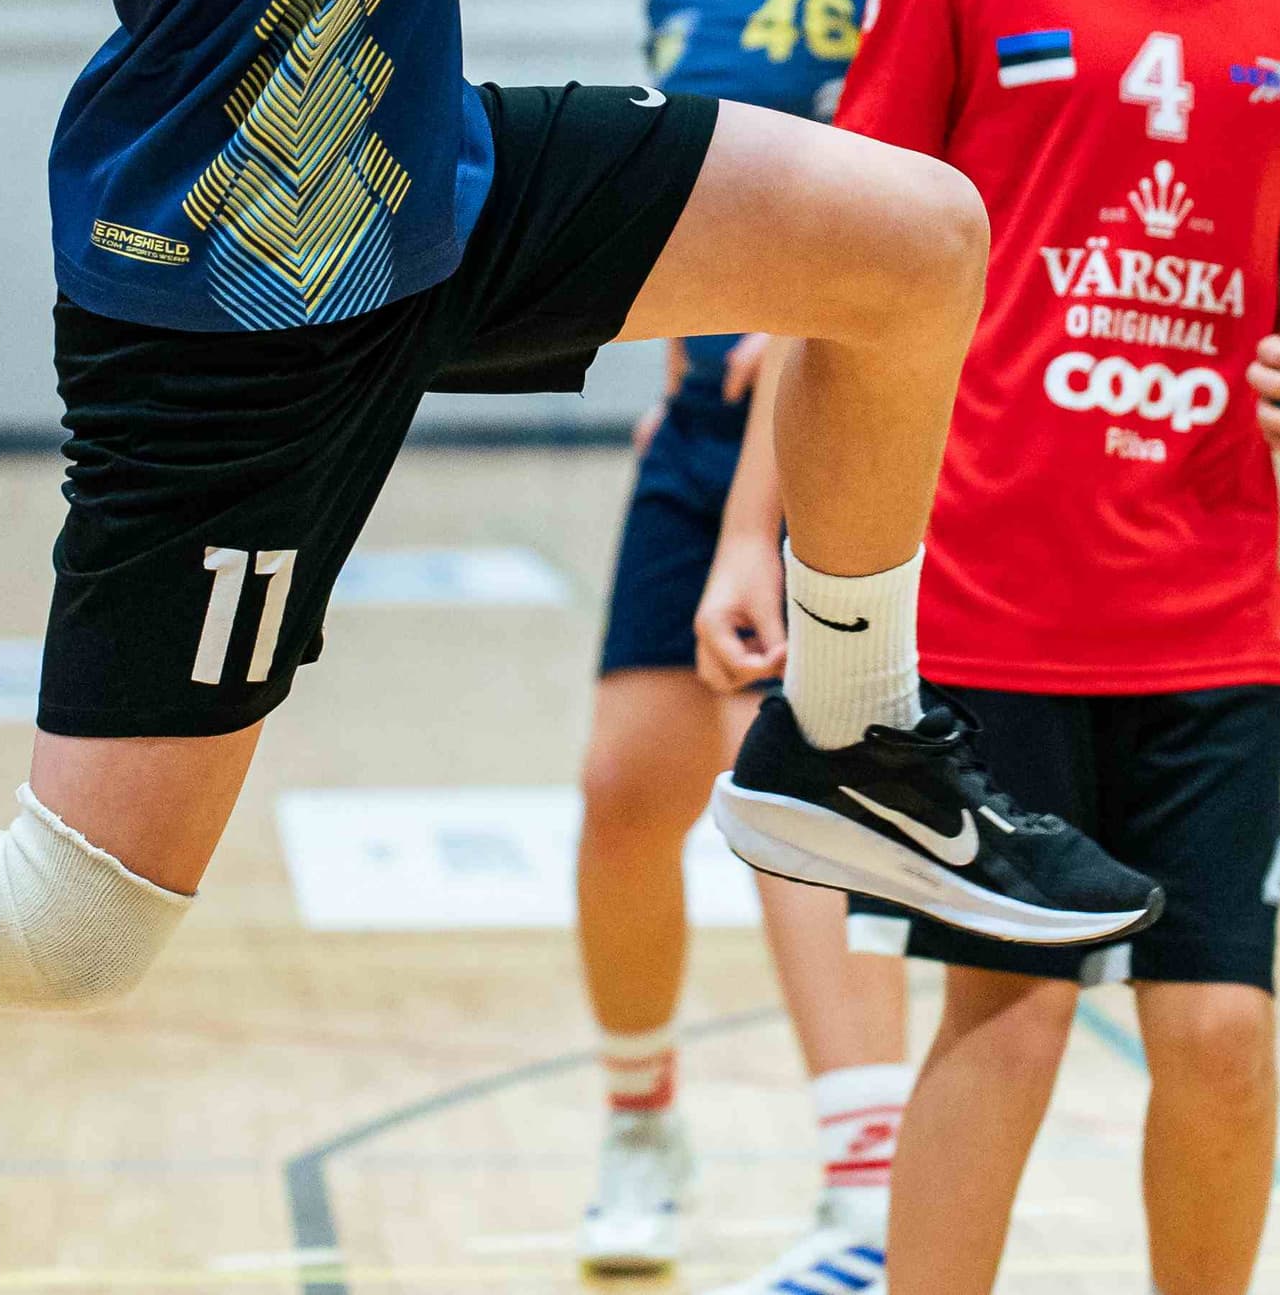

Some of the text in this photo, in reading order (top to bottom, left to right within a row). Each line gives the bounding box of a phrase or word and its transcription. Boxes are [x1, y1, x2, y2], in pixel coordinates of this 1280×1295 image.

[1118, 30, 1195, 144] 4
[94, 222, 190, 257] EAMSHIELD
[1039, 235, 1245, 318] VÄRSKA
[1065, 304, 1219, 356] ORIGINAAL
[1043, 351, 1230, 434] coop
[191, 546, 299, 685] 11
